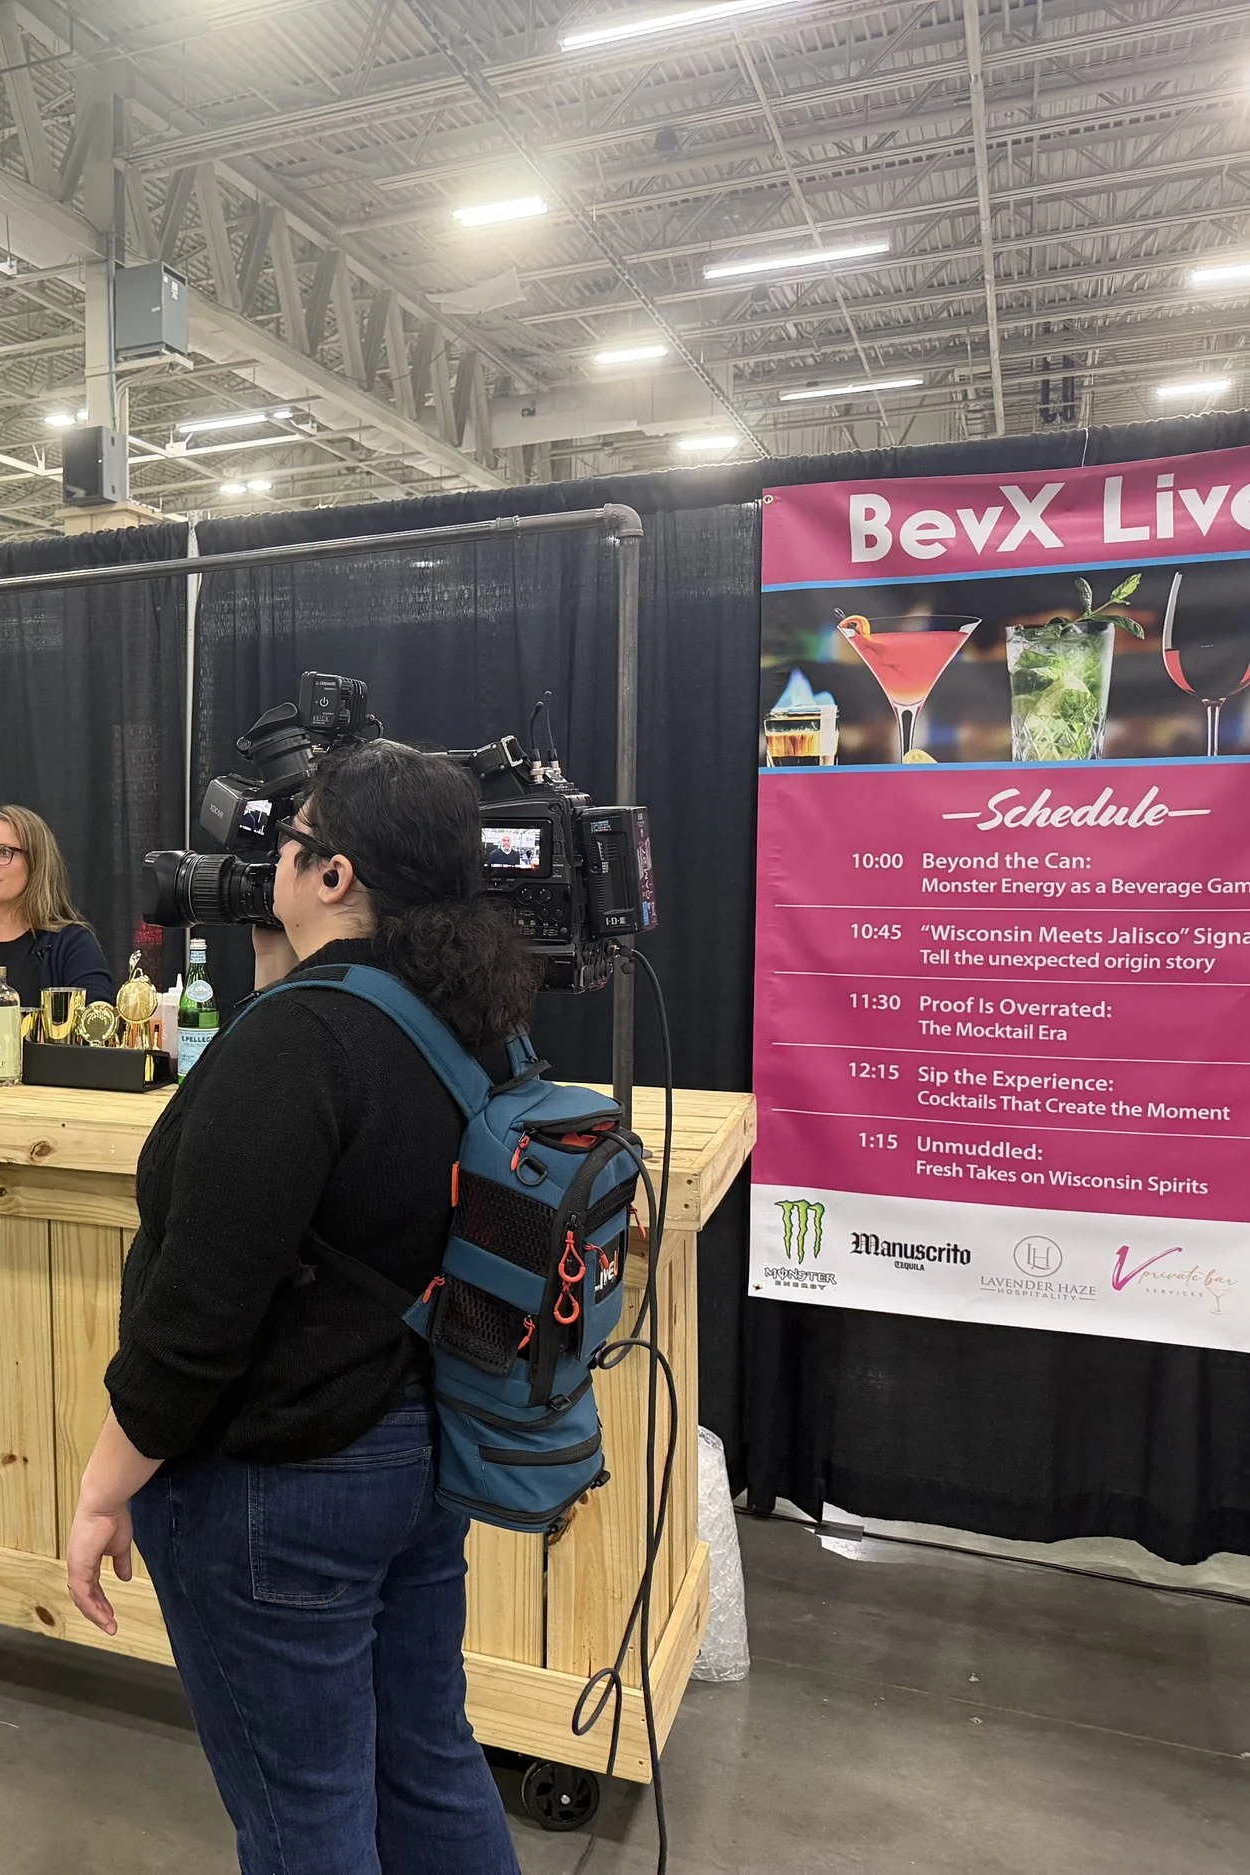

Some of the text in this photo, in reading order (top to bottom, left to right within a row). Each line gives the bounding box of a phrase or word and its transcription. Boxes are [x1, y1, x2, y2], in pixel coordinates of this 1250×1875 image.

[850, 482, 1064, 563] BevX
[977, 786, 1169, 831] Schedule
[852, 853, 904, 869] 10:00
[922, 851, 1091, 874] Beyond the Can:
[921, 877, 998, 893] Monster
[1001, 877, 1067, 898] Energy
[1070, 881, 1091, 894] as
[1095, 881, 1106, 894] a
[1111, 878, 1203, 898] Beverage
[851, 923, 902, 940] 10:45
[1038, 926, 1103, 944] Meets
[919, 948, 1216, 974] Tell the unexpected origin story
[849, 993, 901, 1011] 11:30
[919, 995, 1112, 1018] Proof Is Overrated:
[918, 1019, 1067, 1041] The Mocktail Era
[848, 1062, 900, 1080] 12:15
[918, 1065, 1114, 1092] Sip the Experience:
[917, 1090, 1231, 1121] Cocktails That Create the Moment
[858, 1132, 898, 1150] 1:15
[917, 1136, 1042, 1161] Unmuddled:
[916, 1159, 1209, 1196] Fresh Takes on Wisconsin Spirits
[850, 1232, 972, 1266] Manuscrito
[764, 1266, 837, 1285] MONSTER
[894, 1260, 925, 1271] TEQUILA
[1138, 1264, 1203, 1285] private
[1203, 1266, 1239, 1286] bar
[774, 1280, 827, 1291] ENERGY
[980, 1275, 1096, 1296] LAVENDER HAZE
[997, 1288, 1077, 1302] HOSPITALITY
[1145, 1288, 1204, 1298] SERVICES
